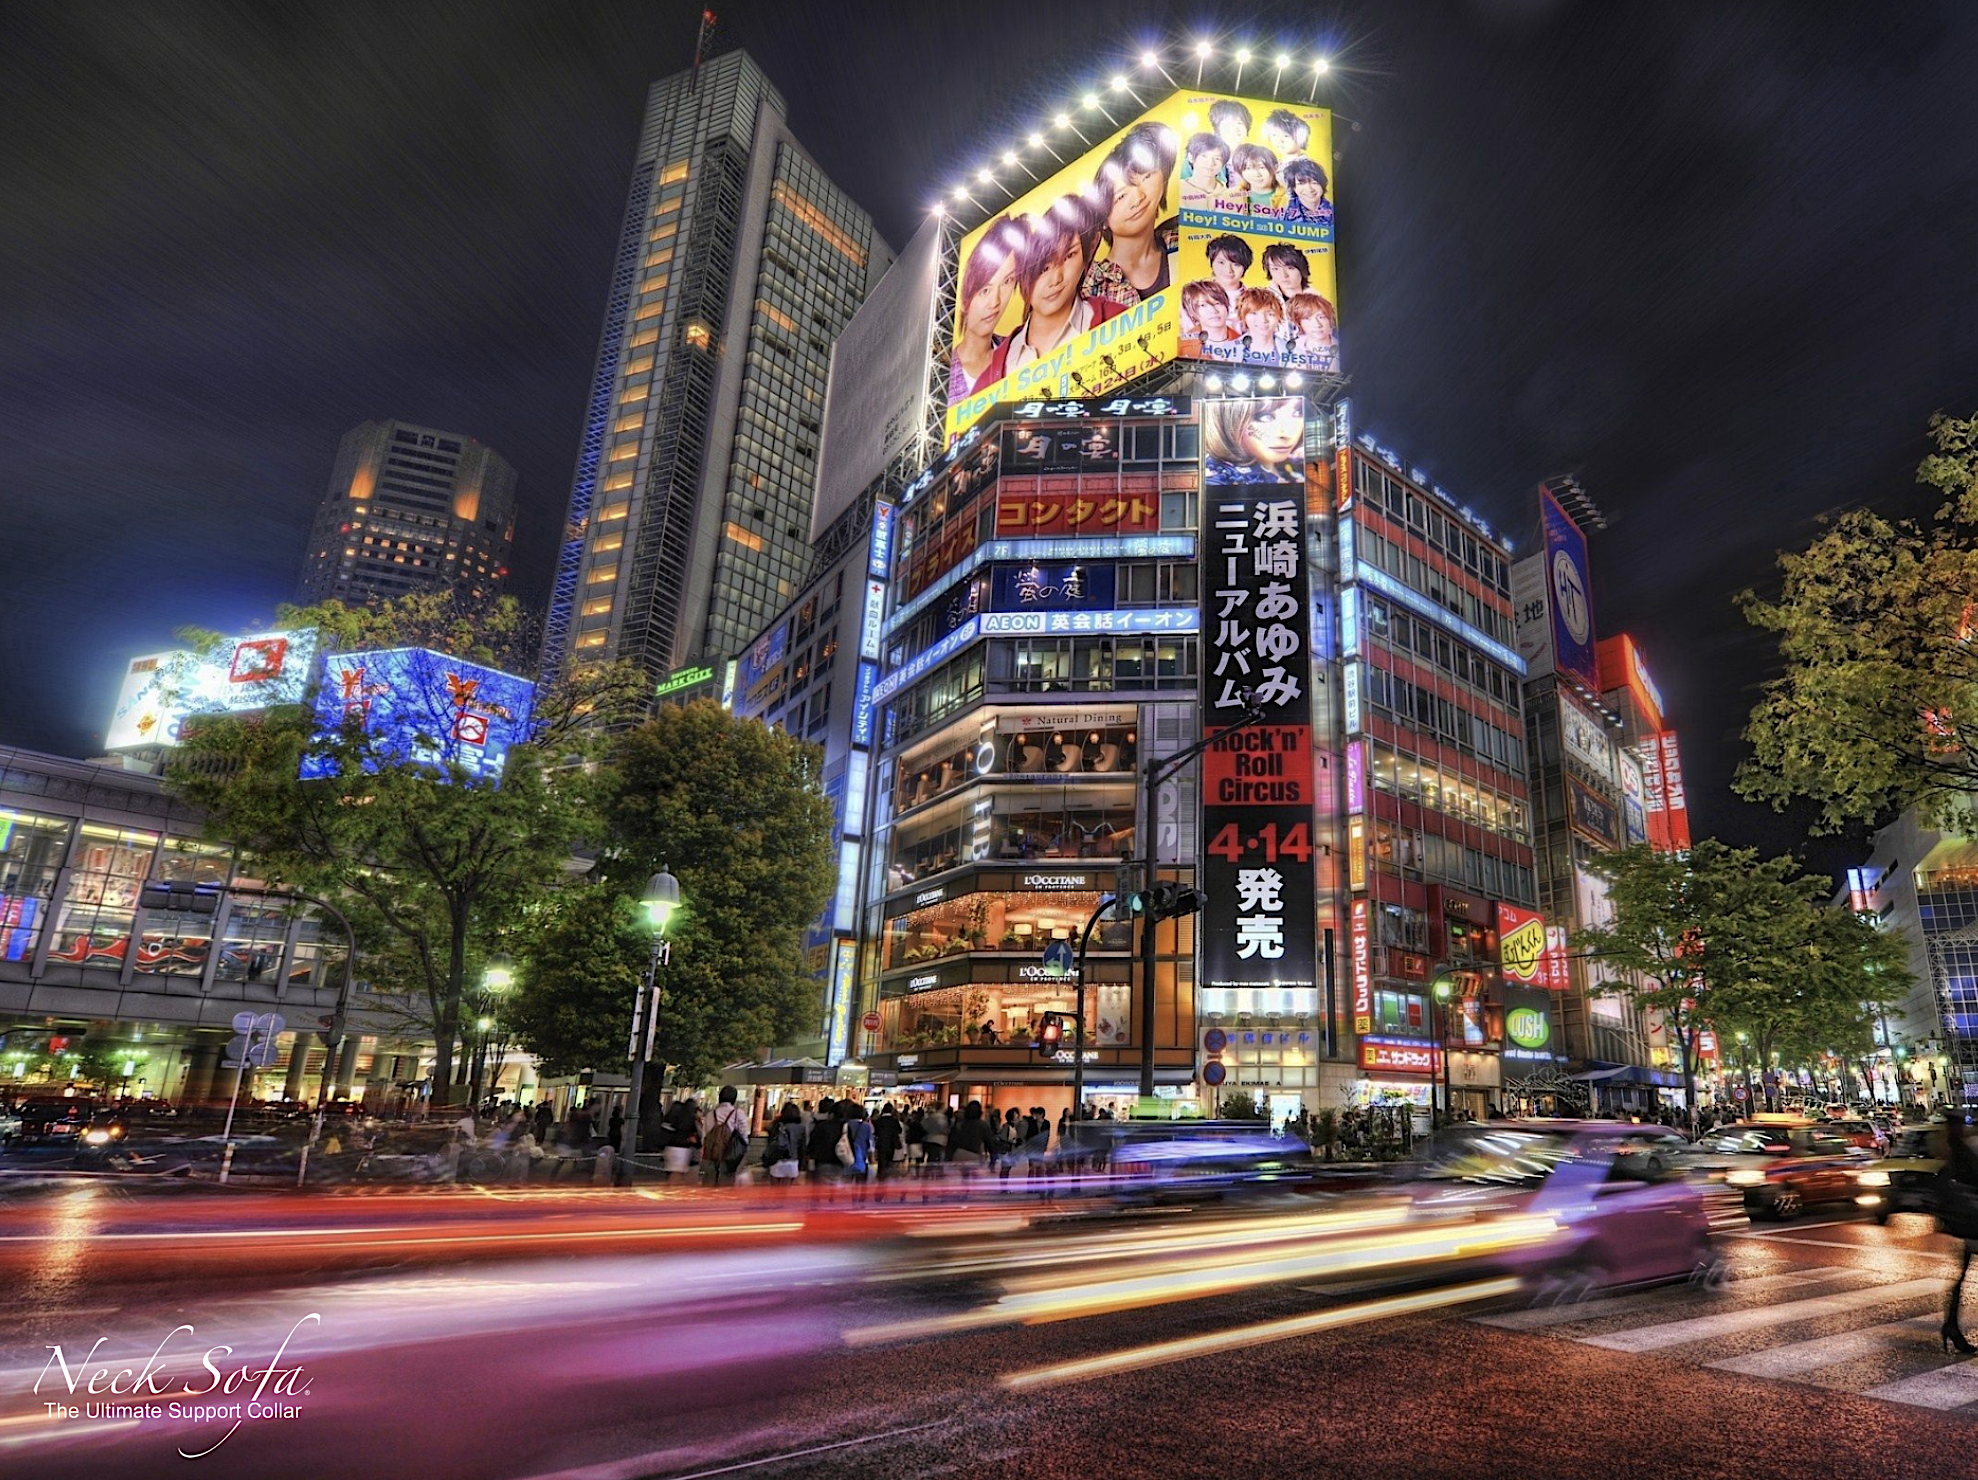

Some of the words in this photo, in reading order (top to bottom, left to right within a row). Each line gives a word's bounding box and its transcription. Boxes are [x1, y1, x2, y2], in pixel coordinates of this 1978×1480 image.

[1214, 198, 1248, 214] Hey!
[1253, 204, 1284, 217] Say!
[1183, 212, 1217, 227] Hey!
[1222, 216, 1254, 231] Say!
[1288, 225, 1330, 238] JUMP
[956, 378, 1009, 425] Hey!
[1017, 344, 1073, 391] Say!
[1082, 295, 1166, 357] JUMP
[1202, 345, 1237, 359] Hey!
[1243, 349, 1275, 363] Say!
[1281, 352, 1314, 365] BEST
[1000, 498, 1153, 526] コンタクト
[1212, 503, 1251, 709] ニューアルバム
[1252, 499, 1302, 707] 浜崎あゆみ
[986, 614, 1040, 631] AEON
[1051, 611, 1194, 631] 英会話イーオン
[656, 676, 685, 693] MARK
[686, 667, 713, 683] CITY
[1037, 715, 1079, 726] Natural
[1084, 713, 1122, 725] Dining
[1213, 728, 1304, 753] Rock'n'
[1235, 753, 1283, 777] Roll
[1218, 778, 1300, 803] Circus
[1024, 874, 1086, 886] L'OCCITANE
[1235, 867, 1284, 960] 発売
[1510, 1011, 1545, 1040] LUSH
